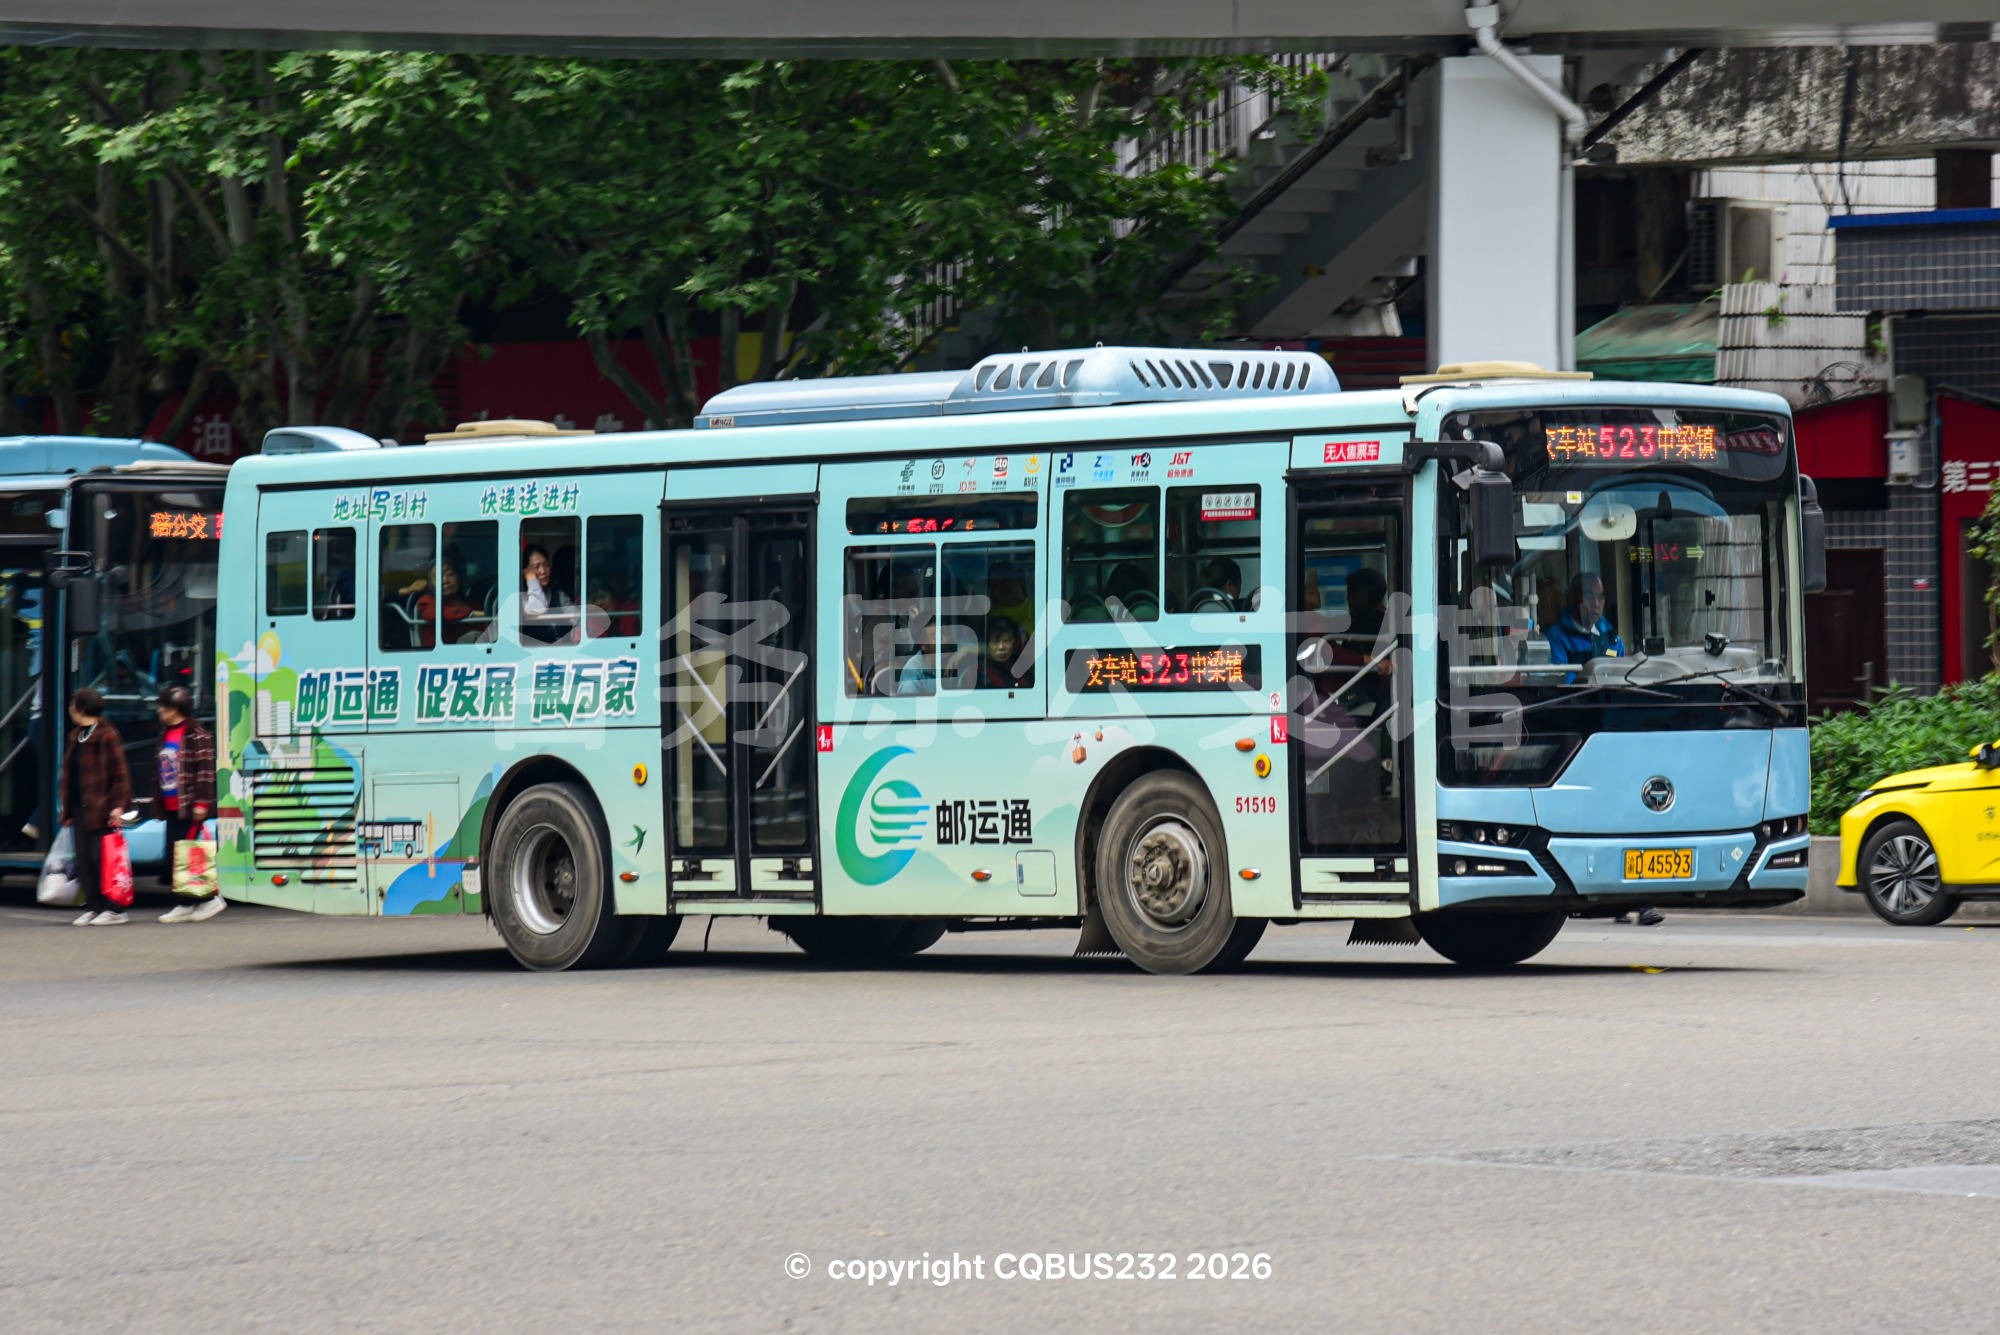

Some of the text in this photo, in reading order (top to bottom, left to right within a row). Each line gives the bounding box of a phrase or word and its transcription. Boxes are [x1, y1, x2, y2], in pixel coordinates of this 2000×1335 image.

[1325, 443, 1378, 461] 无人售票车
[1599, 425, 1657, 458] 523
[1169, 451, 1193, 466] J&T
[1941, 460, 2000, 493] 第三
[333, 489, 428, 522] 地址写到村
[480, 481, 580, 516] 快递送进村
[1140, 654, 1190, 684] 523
[296, 656, 639, 727] 邮运通 促发展 惠万家
[935, 798, 1032, 845] 邮运通
[1235, 797, 1276, 814] 51519
